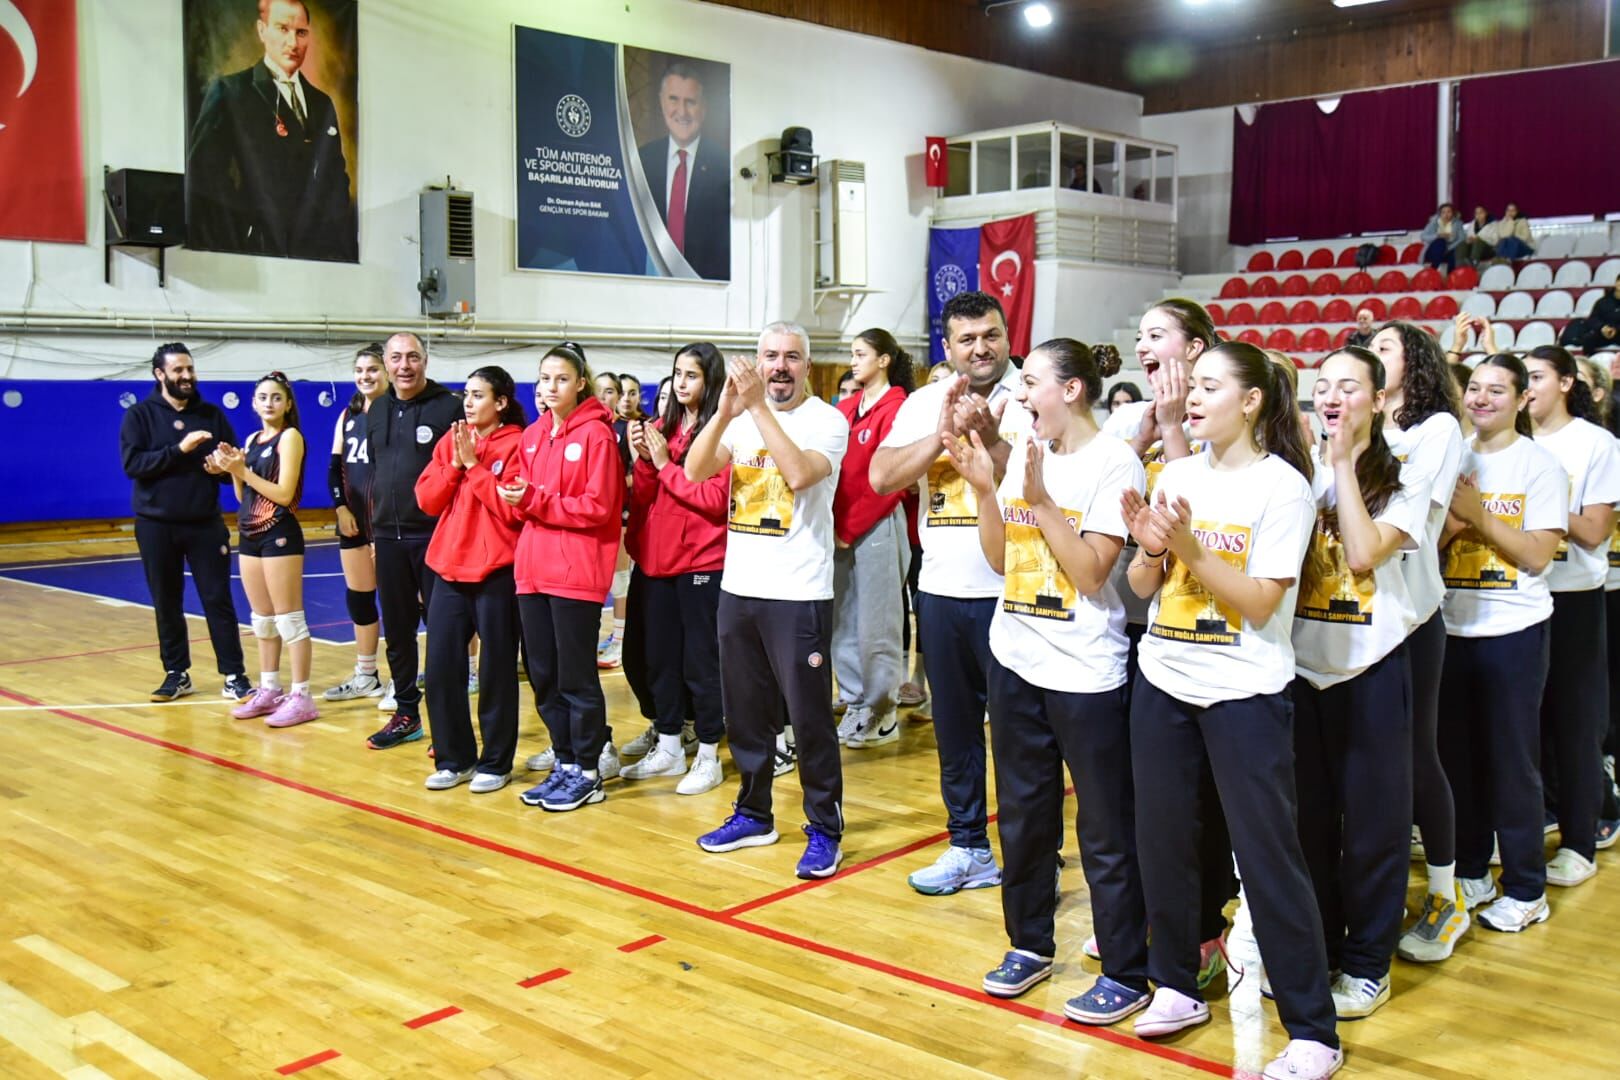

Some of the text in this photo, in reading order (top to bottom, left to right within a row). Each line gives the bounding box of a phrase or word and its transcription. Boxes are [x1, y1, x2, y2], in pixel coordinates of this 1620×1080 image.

[536, 146, 612, 166] TÜM ANTRENÖR
[525, 158, 622, 179] VE SPORCULARIMIZA
[528, 172, 619, 190] BAŞARILAR DİLİYORUM
[346, 437, 369, 464] 24
